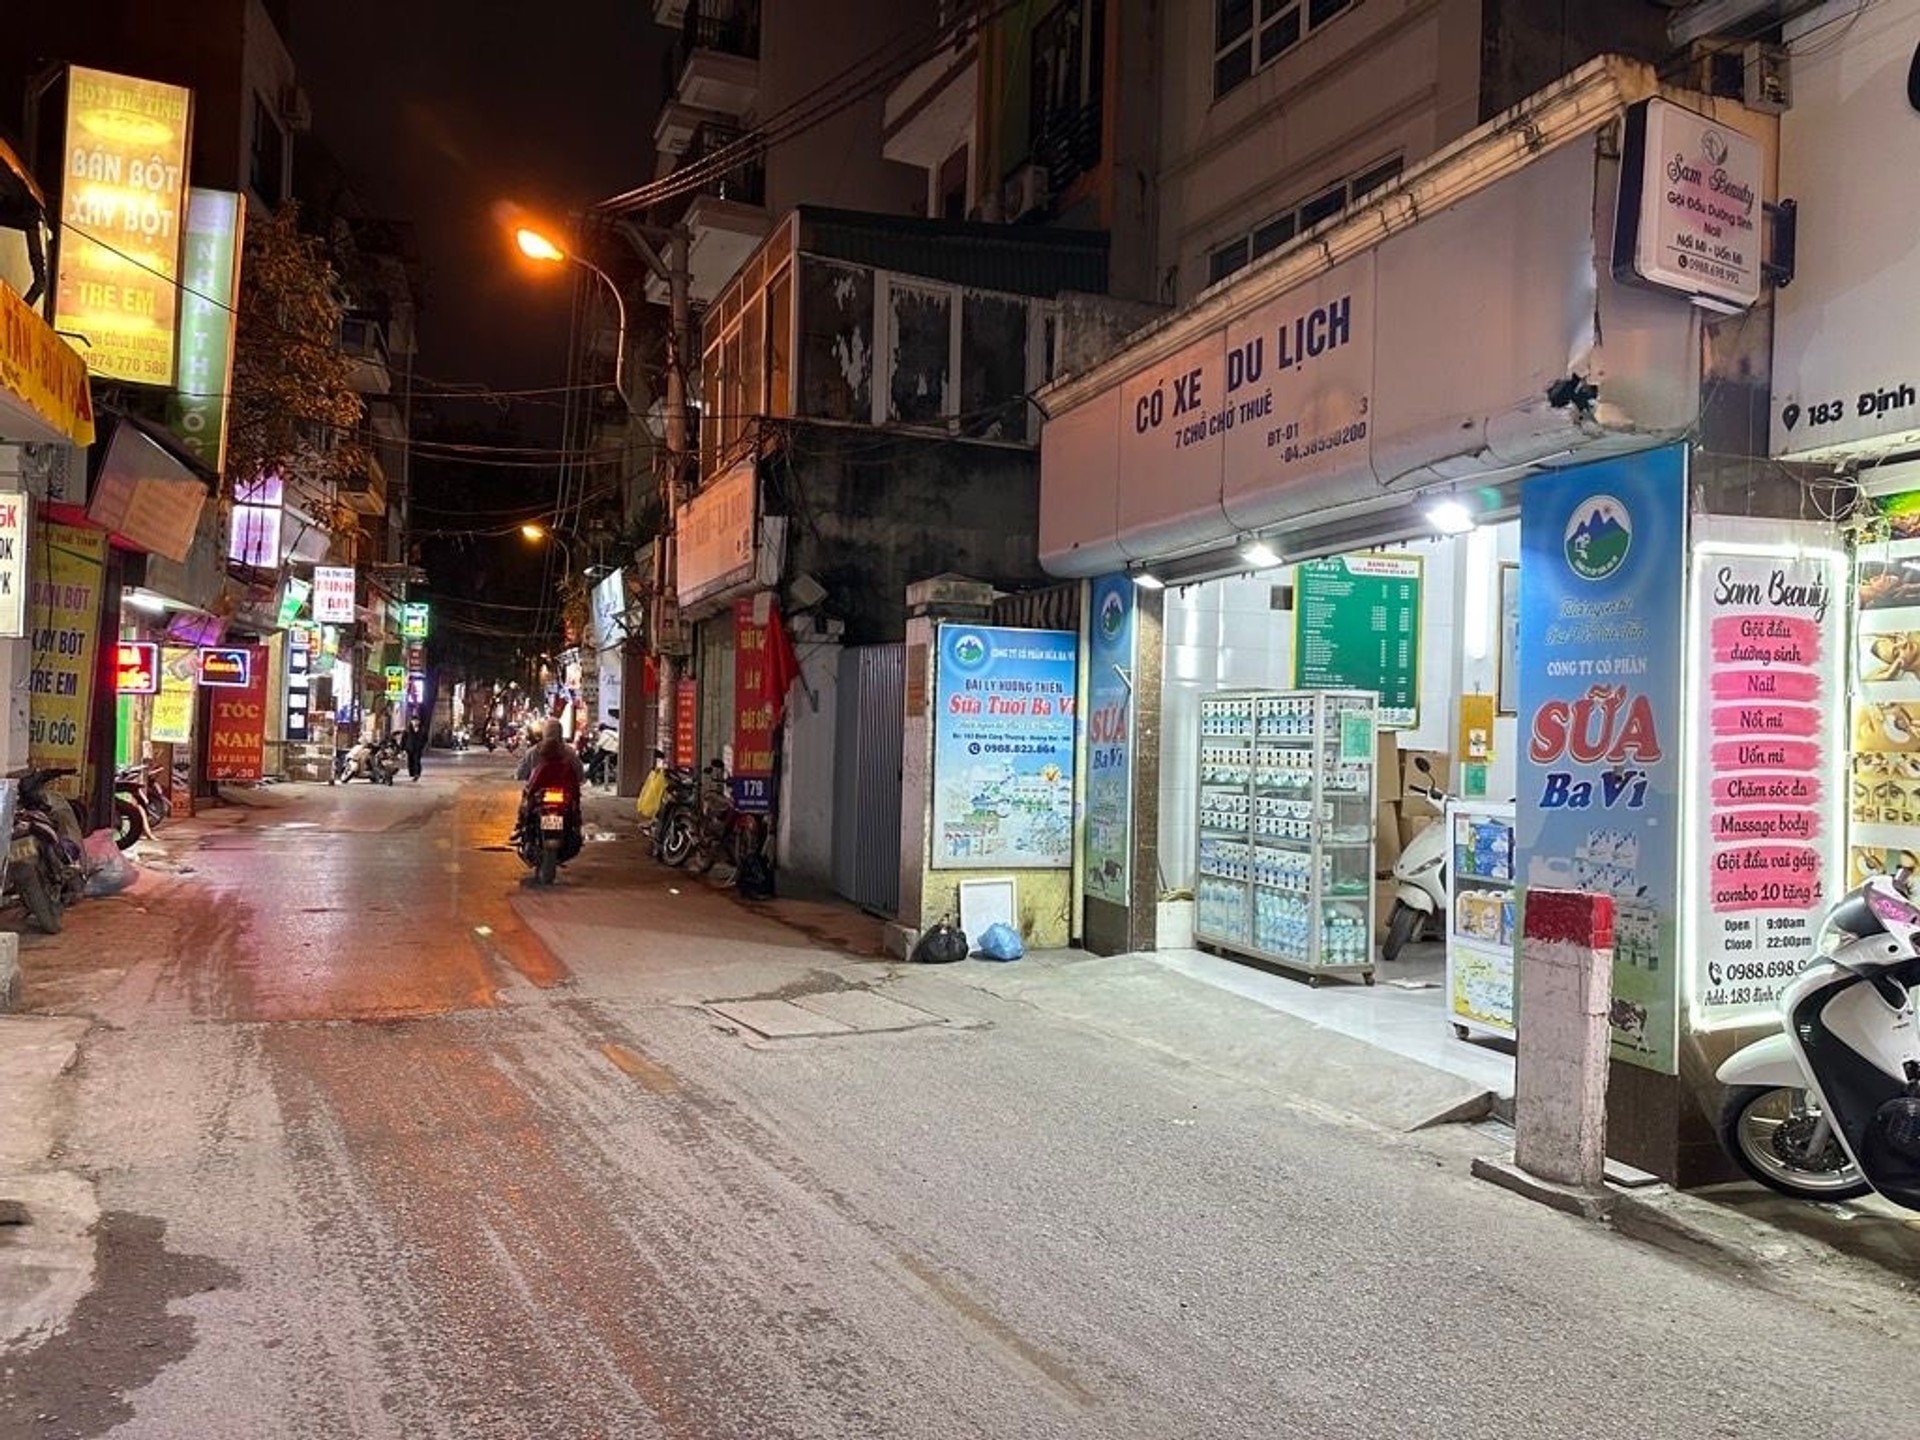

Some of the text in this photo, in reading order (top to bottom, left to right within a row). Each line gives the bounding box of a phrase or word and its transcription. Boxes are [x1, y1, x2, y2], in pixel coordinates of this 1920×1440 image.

[1667, 153, 1755, 216] Sam Beauty
[1136, 295, 1351, 434] CÓ XE DU LỊCH
[1807, 383, 1916, 427] 183 Định
[1175, 429, 1183, 450] 7
[1714, 566, 1831, 624] Sam Beauty
[1740, 619, 1792, 641] Gội đầu
[1730, 644, 1802, 667] dưỡng sinh
[1747, 674, 1776, 693] Nail
[1529, 683, 1664, 766] SỮA
[1739, 709, 1784, 730] Nối mi
[213, 732, 262, 749] NAM
[1738, 745, 1785, 765] Uốn mi
[1539, 771, 1593, 809] Ba
[1728, 778, 1808, 799] Chăm sóc da
[1721, 815, 1810, 838] Massage body
[1716, 852, 1741, 874] Gội
[1770, 852, 1791, 870] vai
[1792, 852, 1816, 873] gáy
[1716, 881, 1824, 905] combo 10 tặng 1
[1725, 917, 1807, 933] Open 9:00am
[1724, 935, 1813, 951] Close 22:00pm
[1726, 960, 1807, 981] 0988.698.9
[1730, 986, 1752, 1005] 183
